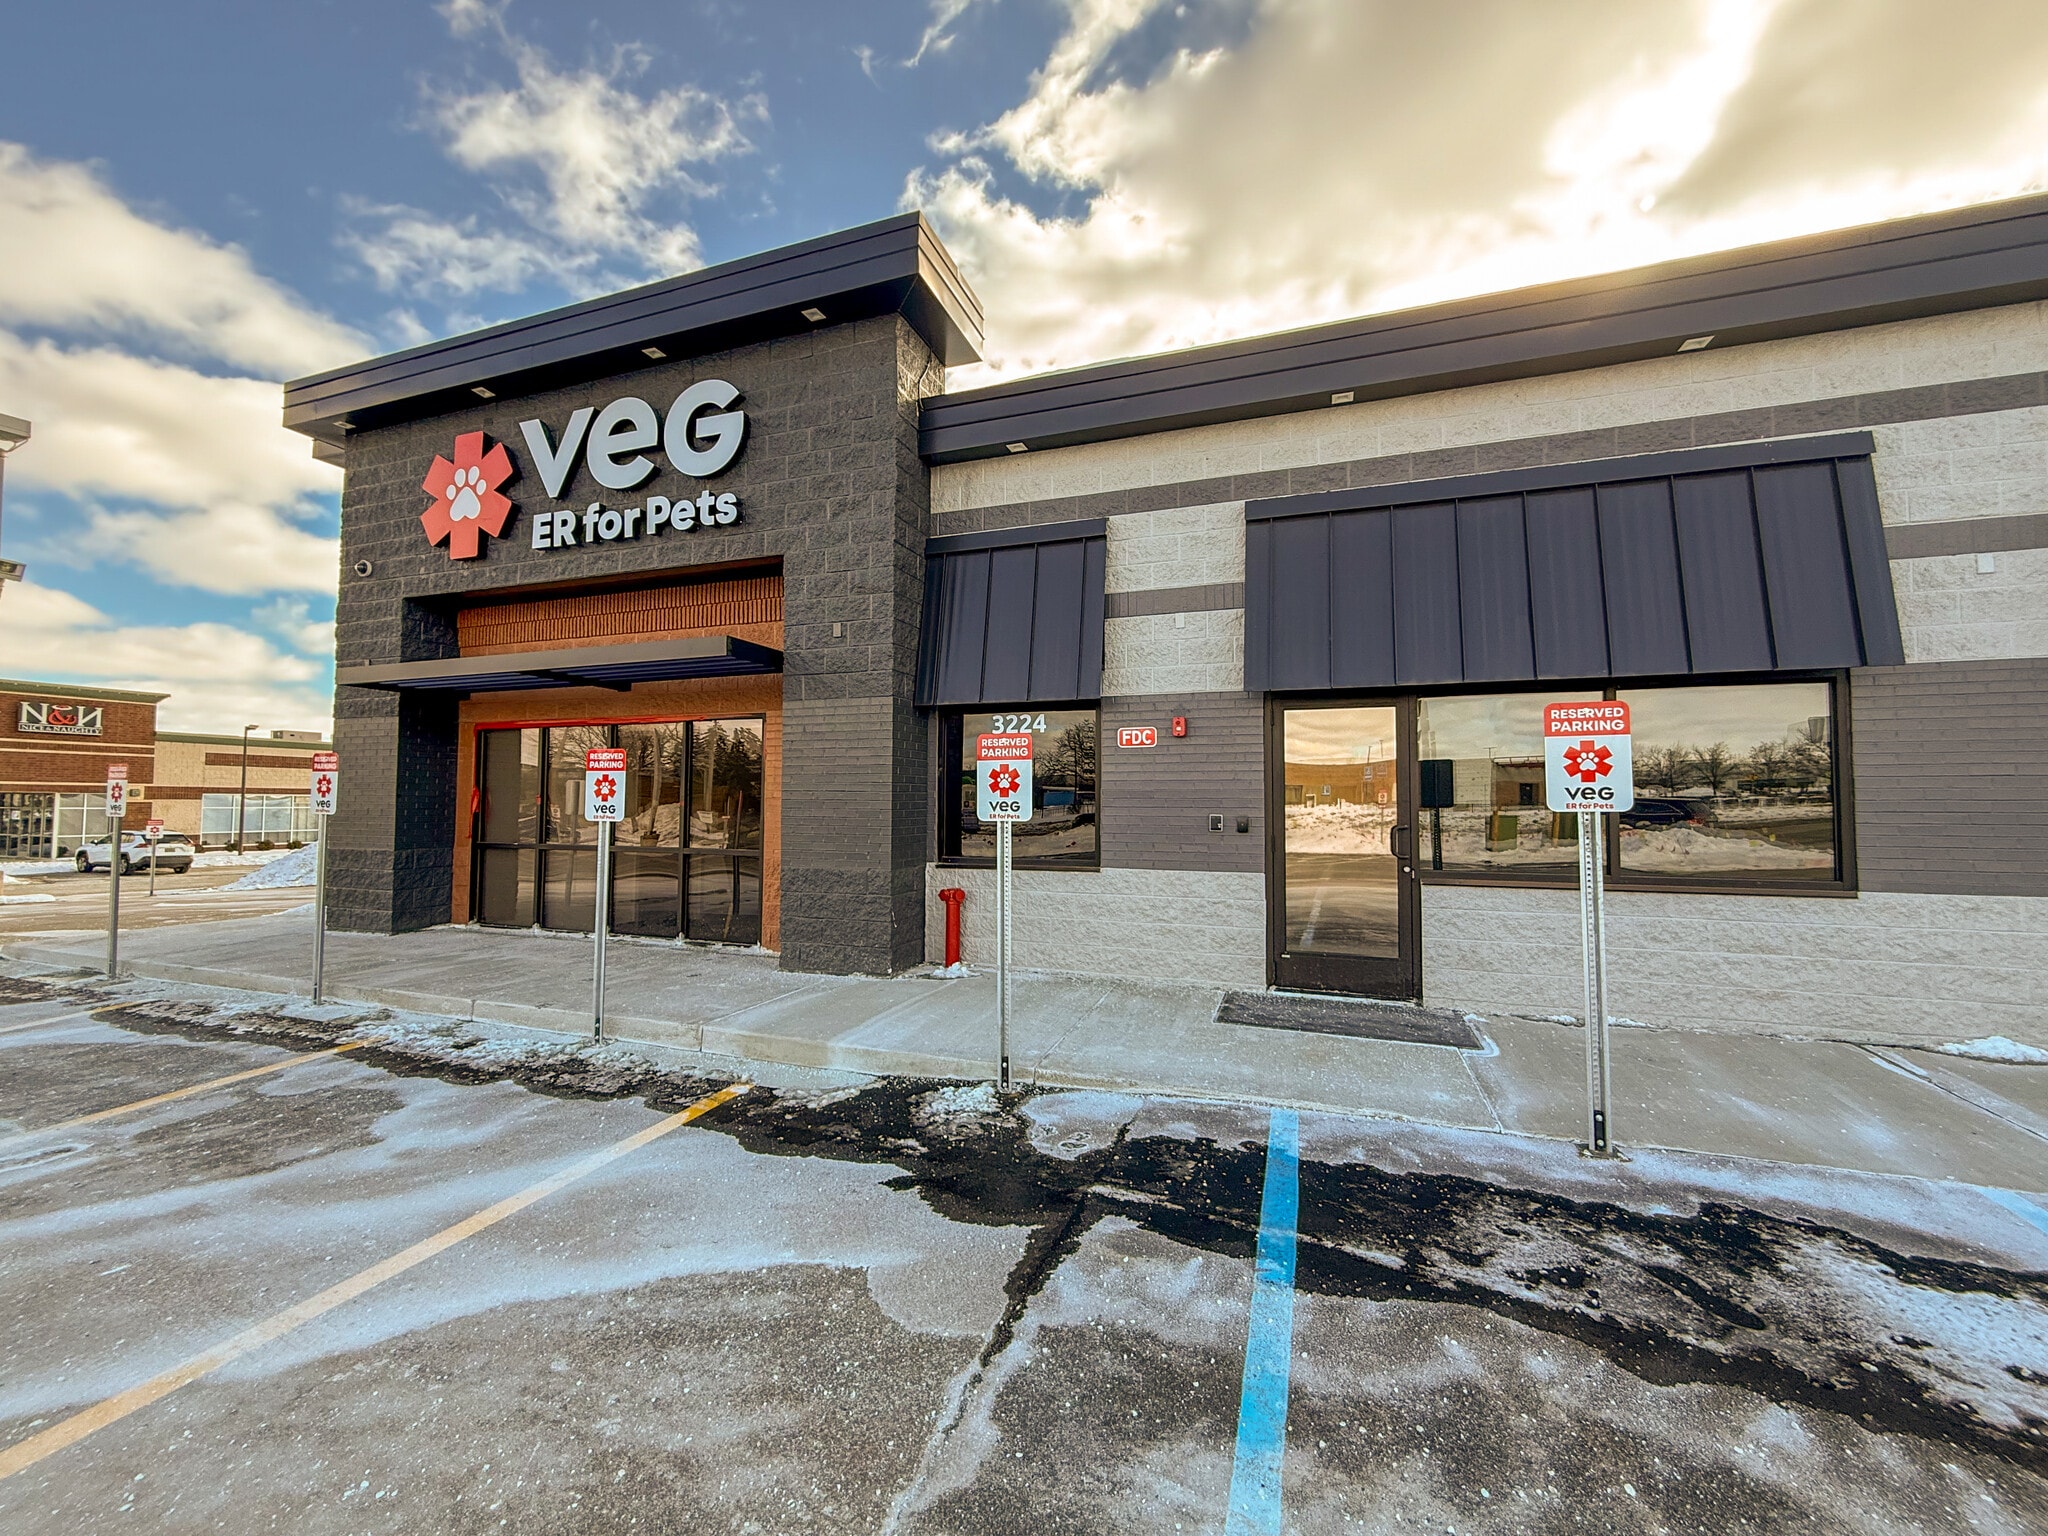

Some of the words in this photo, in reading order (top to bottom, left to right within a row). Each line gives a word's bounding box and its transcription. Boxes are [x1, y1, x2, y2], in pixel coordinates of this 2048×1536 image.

[531, 509, 577, 549] ER
[582, 502, 641, 543] for
[646, 490, 738, 535] Pets
[1551, 708, 1624, 719] RESERVED
[991, 713, 1047, 735] 3224
[1551, 720, 1624, 732] PARKING
[981, 737, 1029, 747] RESERVED
[1121, 730, 1152, 745] FDC
[981, 747, 1029, 757] PARKING
[1579, 802, 1592, 810] for
[1593, 802, 1615, 810] Pets
